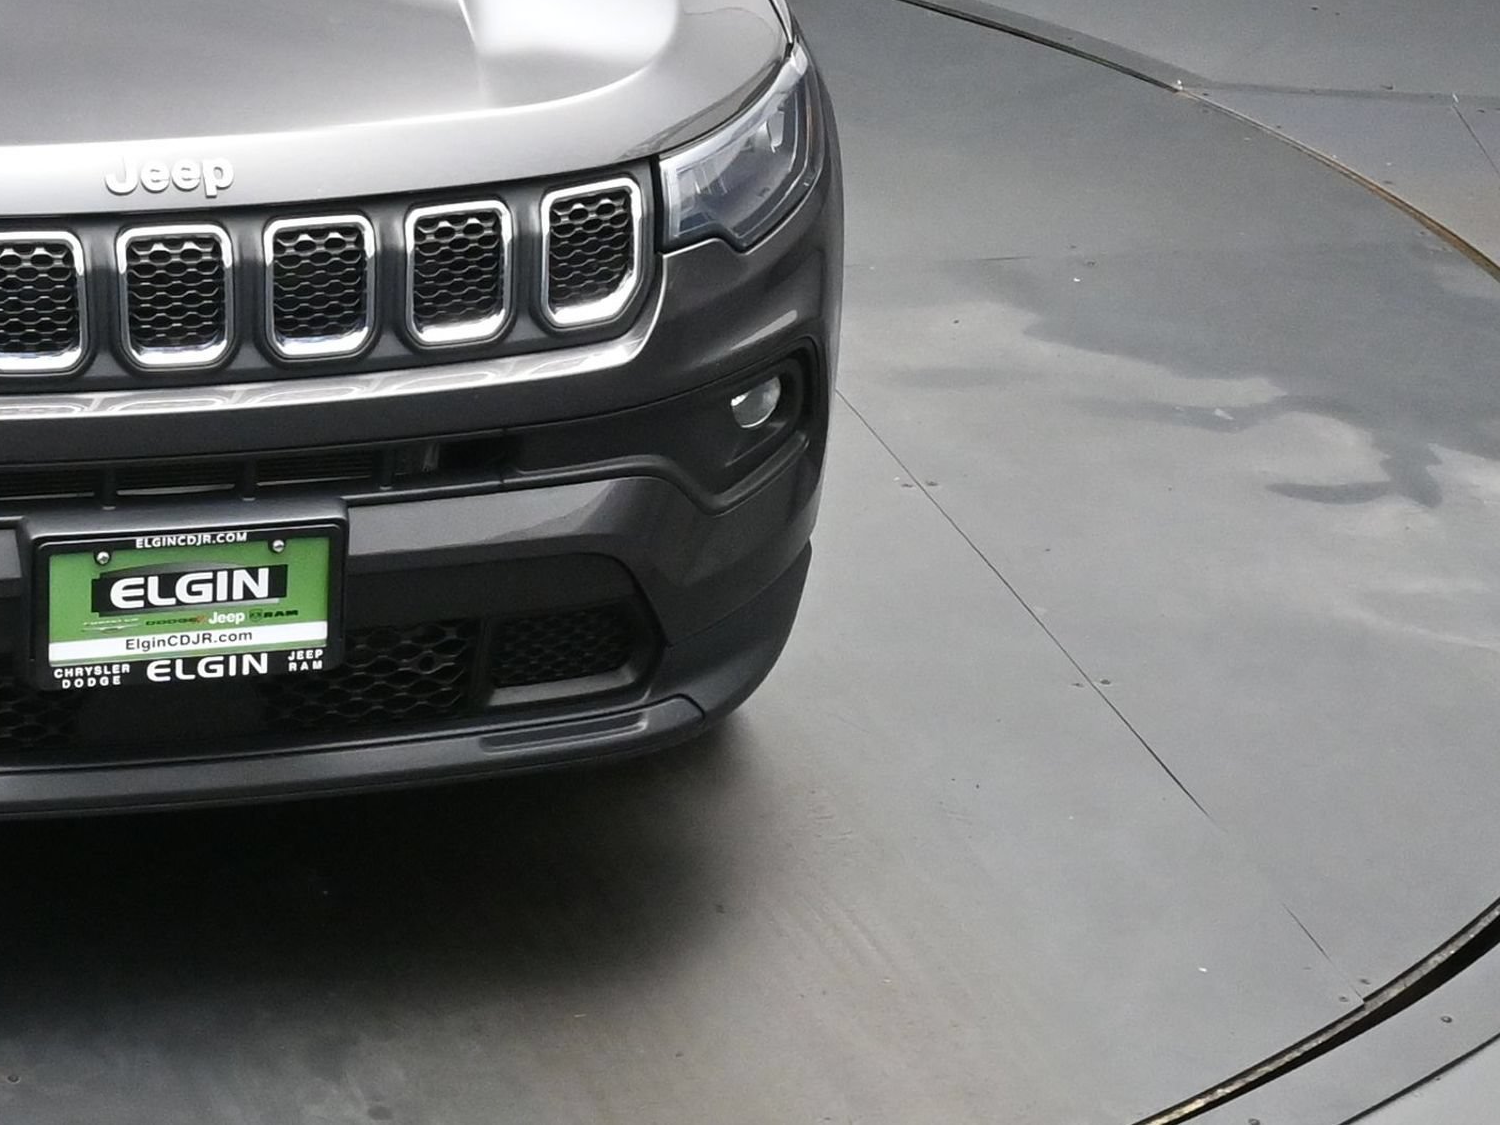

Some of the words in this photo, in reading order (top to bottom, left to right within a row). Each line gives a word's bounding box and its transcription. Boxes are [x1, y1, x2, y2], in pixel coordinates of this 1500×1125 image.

[104, 156, 235, 198] Jeep
[135, 532, 248, 549] ELGINCDJR.COM
[110, 567, 269, 609] ELGIN
[208, 611, 245, 625] Jeep
[263, 609, 299, 619] RAM
[125, 630, 253, 652] ElginCDJR.com
[288, 649, 323, 661] JEEP
[54, 663, 131, 679] CHRYSLER
[147, 652, 268, 683] ELGIN
[288, 660, 323, 672] RAM
[62, 675, 122, 689] DODGE
